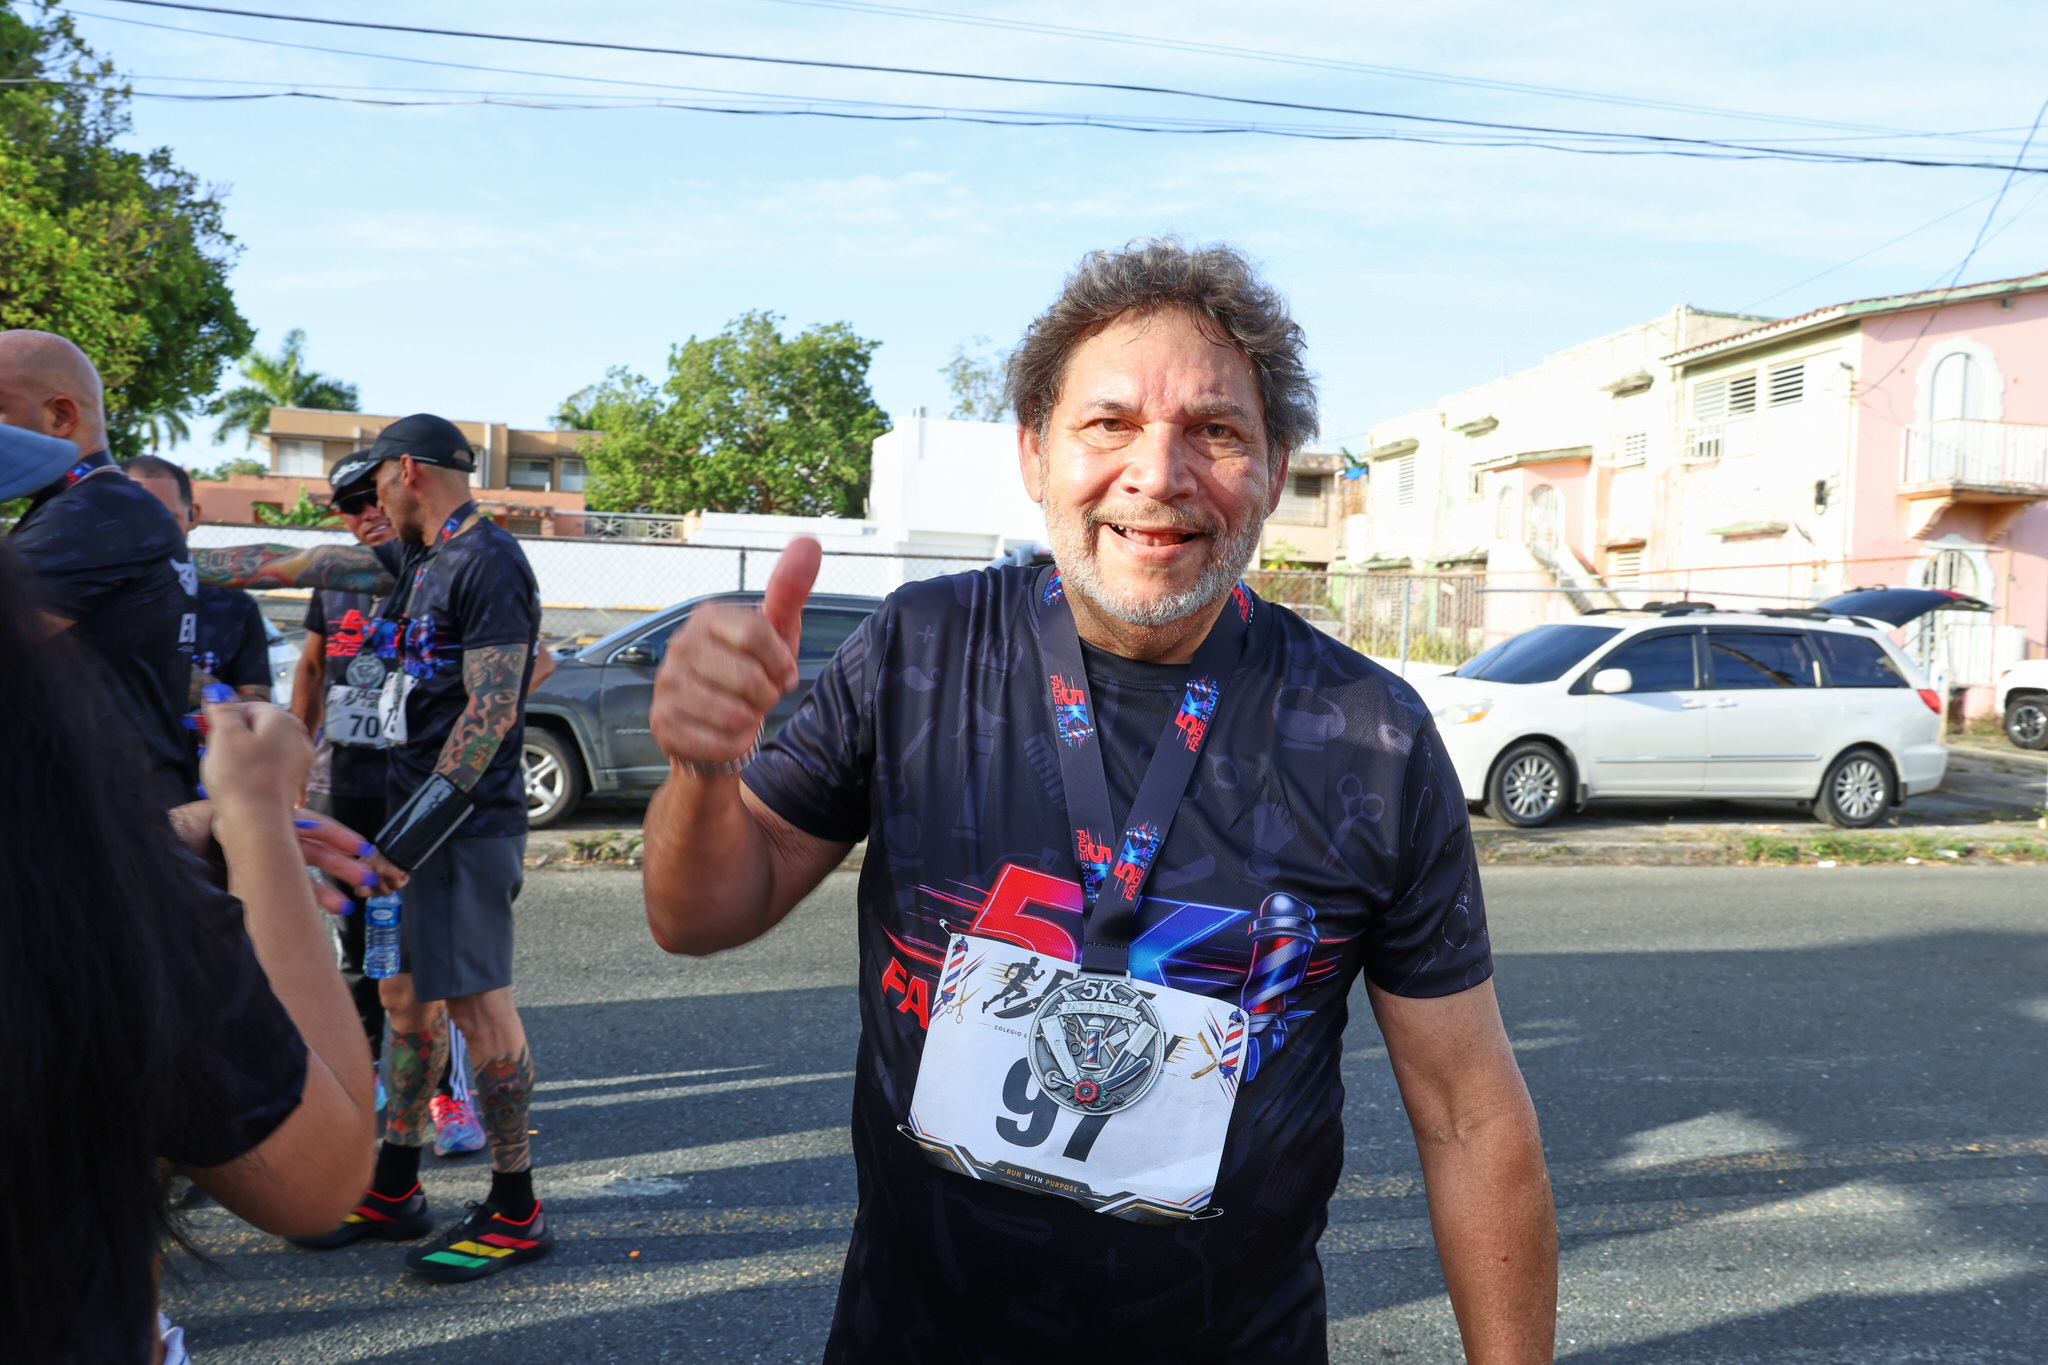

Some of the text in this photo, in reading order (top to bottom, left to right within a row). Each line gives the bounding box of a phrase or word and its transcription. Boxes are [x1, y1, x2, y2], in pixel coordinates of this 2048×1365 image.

[350, 714, 380, 738] 70
[1049, 675, 1069, 738] FADE & RUN
[1062, 687, 1089, 726] 5K
[1174, 689, 1207, 735] 5K
[1188, 689, 1220, 753] FADE & RUN
[1076, 829, 1096, 899] FADE & RUN
[1087, 842, 1113, 882] 5K
[1113, 838, 1147, 883] 5K
[1125, 836, 1160, 901] FADE & RUN
[881, 956, 929, 1030] FA
[1064, 1002, 1133, 1018] FADE & RUN
[1080, 979, 1119, 1002] 5K
[993, 1025, 1022, 1037] COLEGIO
[995, 1057, 1113, 1162] 97
[1006, 1168, 1079, 1193] RUN WITH PURPOSE
